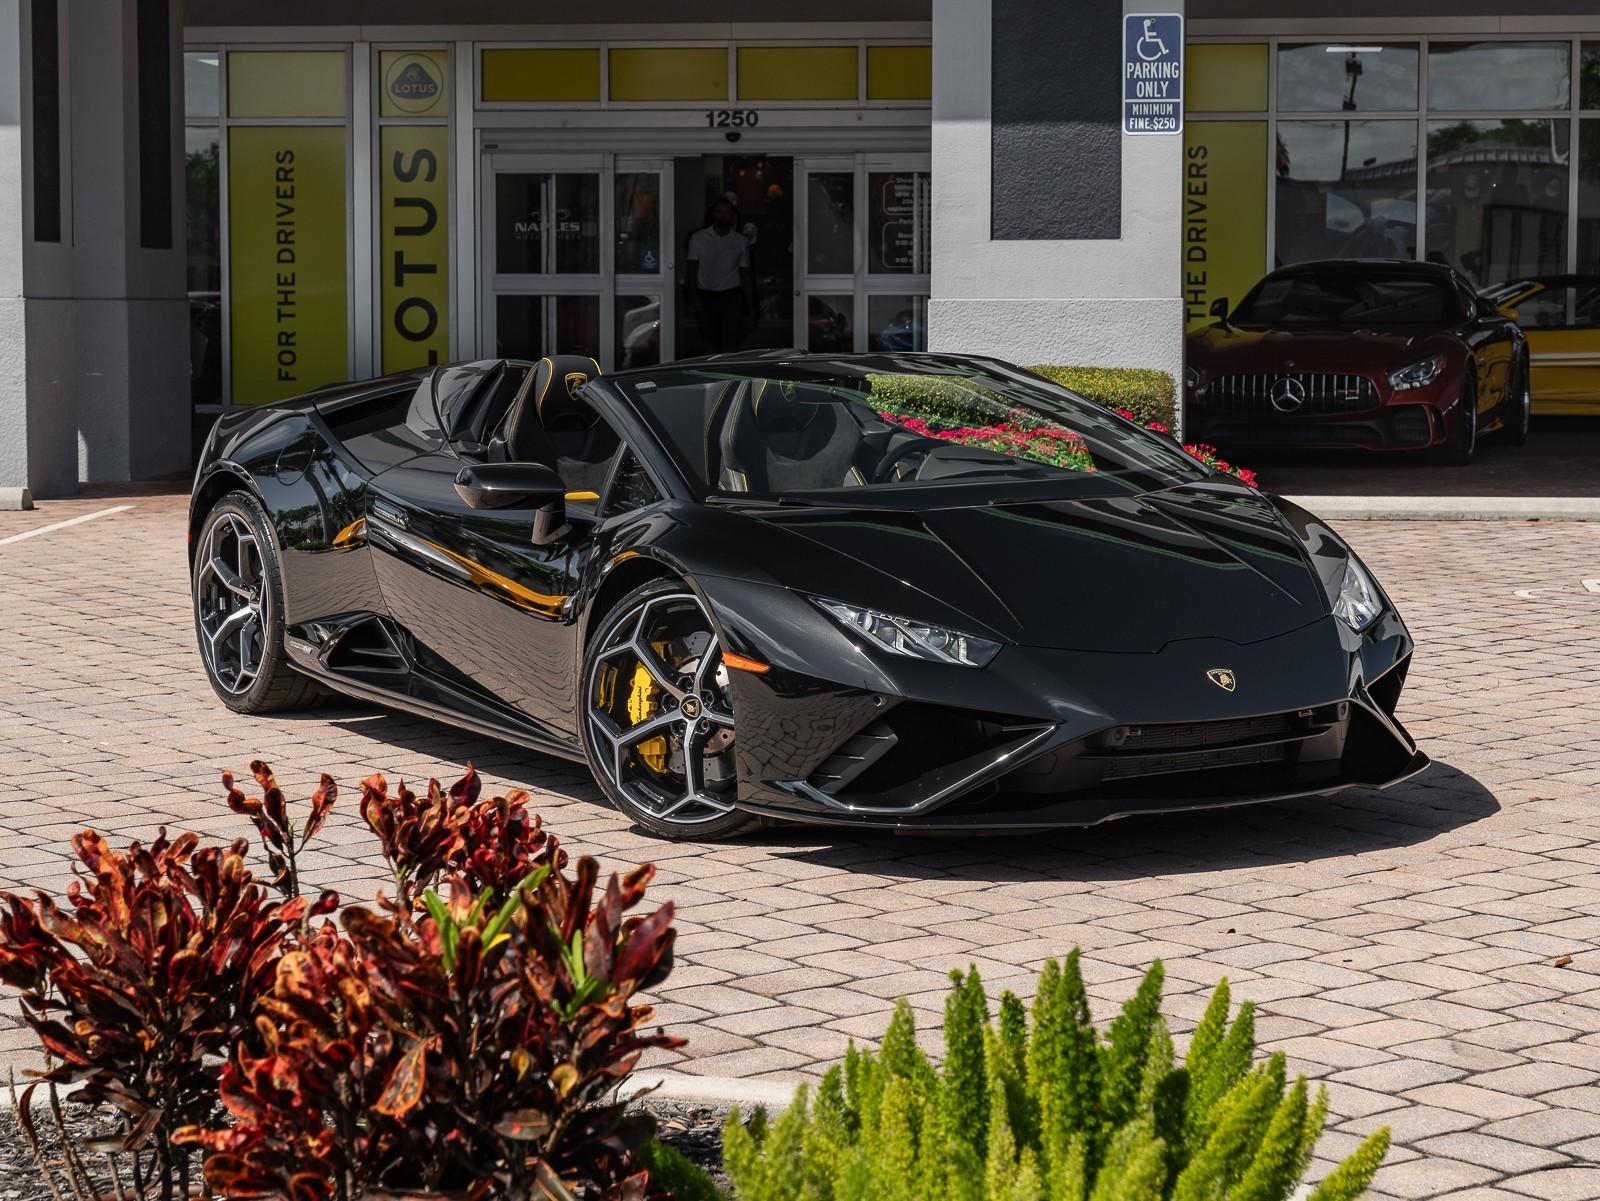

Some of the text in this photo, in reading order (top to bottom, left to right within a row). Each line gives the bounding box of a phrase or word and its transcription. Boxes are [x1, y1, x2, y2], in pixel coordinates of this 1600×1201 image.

[1127, 62, 1179, 79] PARKING
[394, 83, 435, 94] LOTUS
[1136, 81, 1169, 97] ONLY
[1132, 103, 1173, 115] MINIMUM
[705, 110, 759, 128] 1250
[1129, 116, 1176, 131] FINE $250
[515, 222, 580, 233] NALES
[1186, 145, 1208, 323] THE DRIVERS
[275, 150, 296, 382] FOR THE DRIVERS
